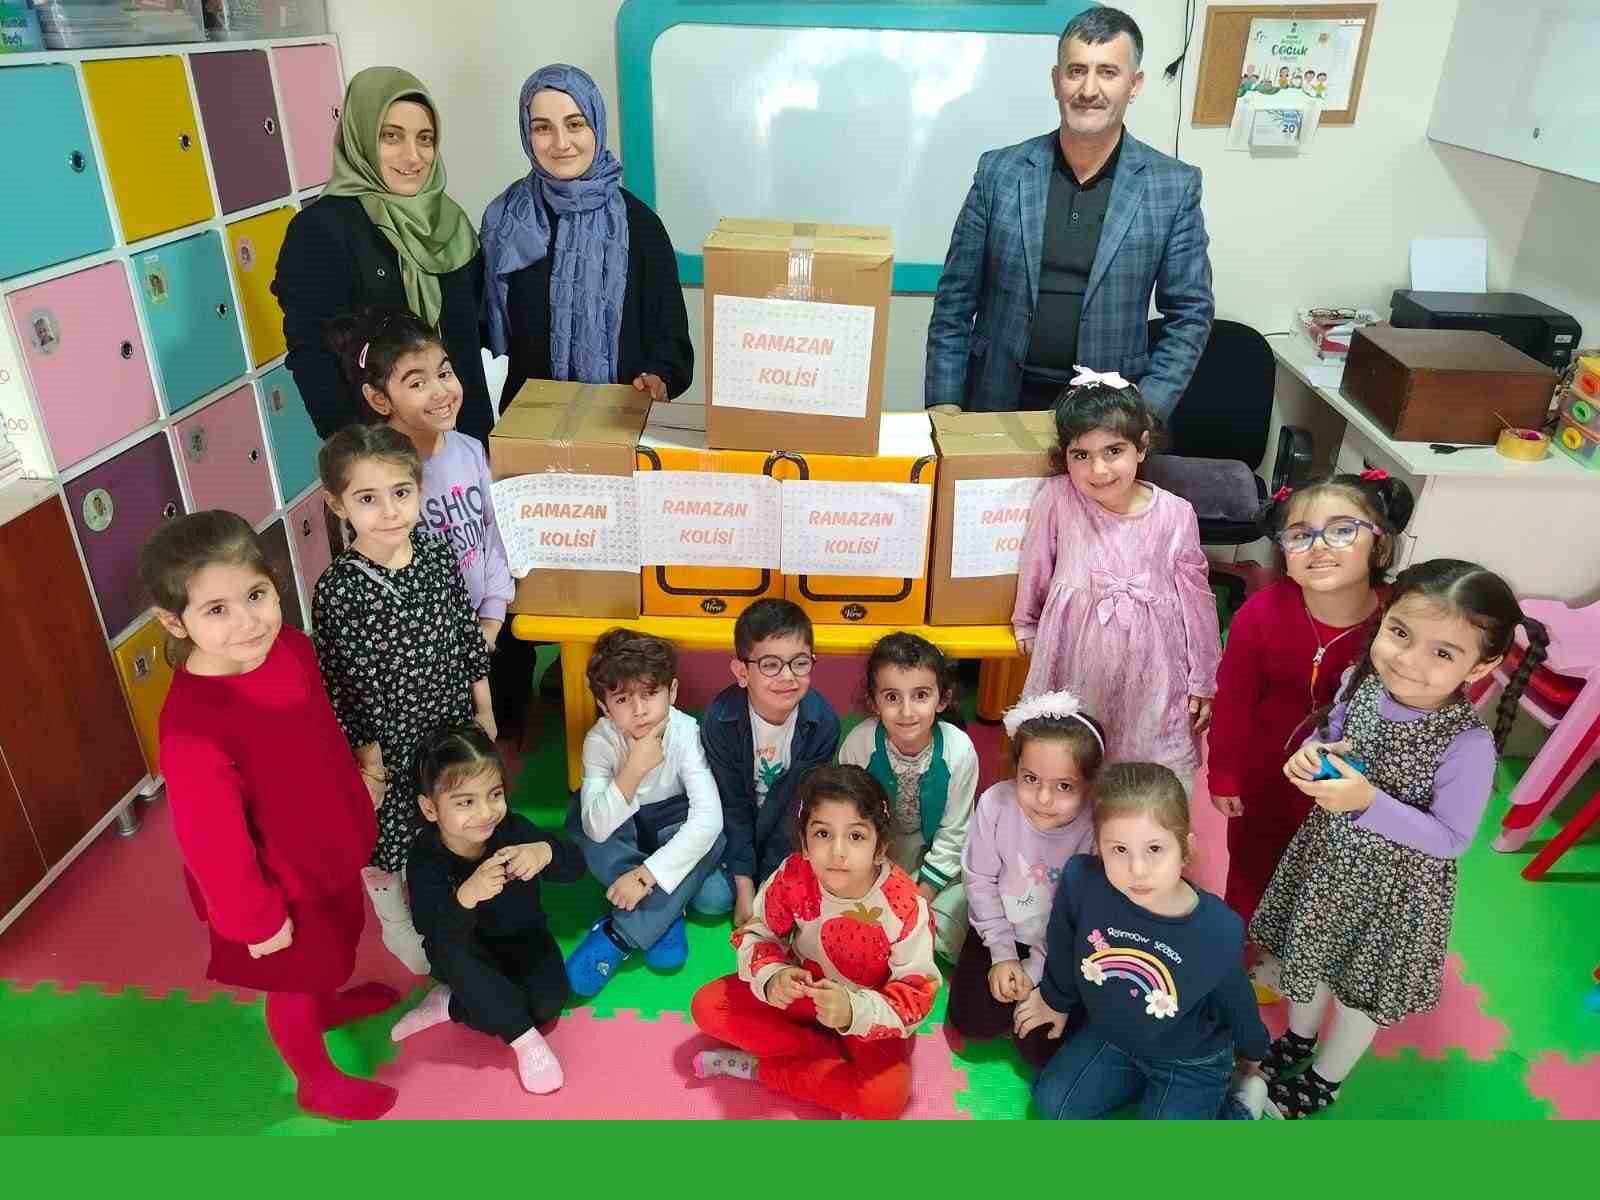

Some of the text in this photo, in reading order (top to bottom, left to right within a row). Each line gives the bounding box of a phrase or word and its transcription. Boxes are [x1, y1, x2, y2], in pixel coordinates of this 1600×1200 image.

[1282, 124, 1296, 133] 20
[742, 331, 834, 356] RAMAZAN
[758, 366, 820, 387] KOLİSİ
[520, 502, 608, 519] RAMAZAN
[661, 499, 748, 517] RAMAZAN
[981, 508, 1032, 524] RAMA
[808, 509, 895, 527] RAMAZAN
[540, 529, 597, 548] KOLİSİ
[680, 527, 736, 545] KOLİSİ
[823, 537, 881, 554] KOLİSİ
